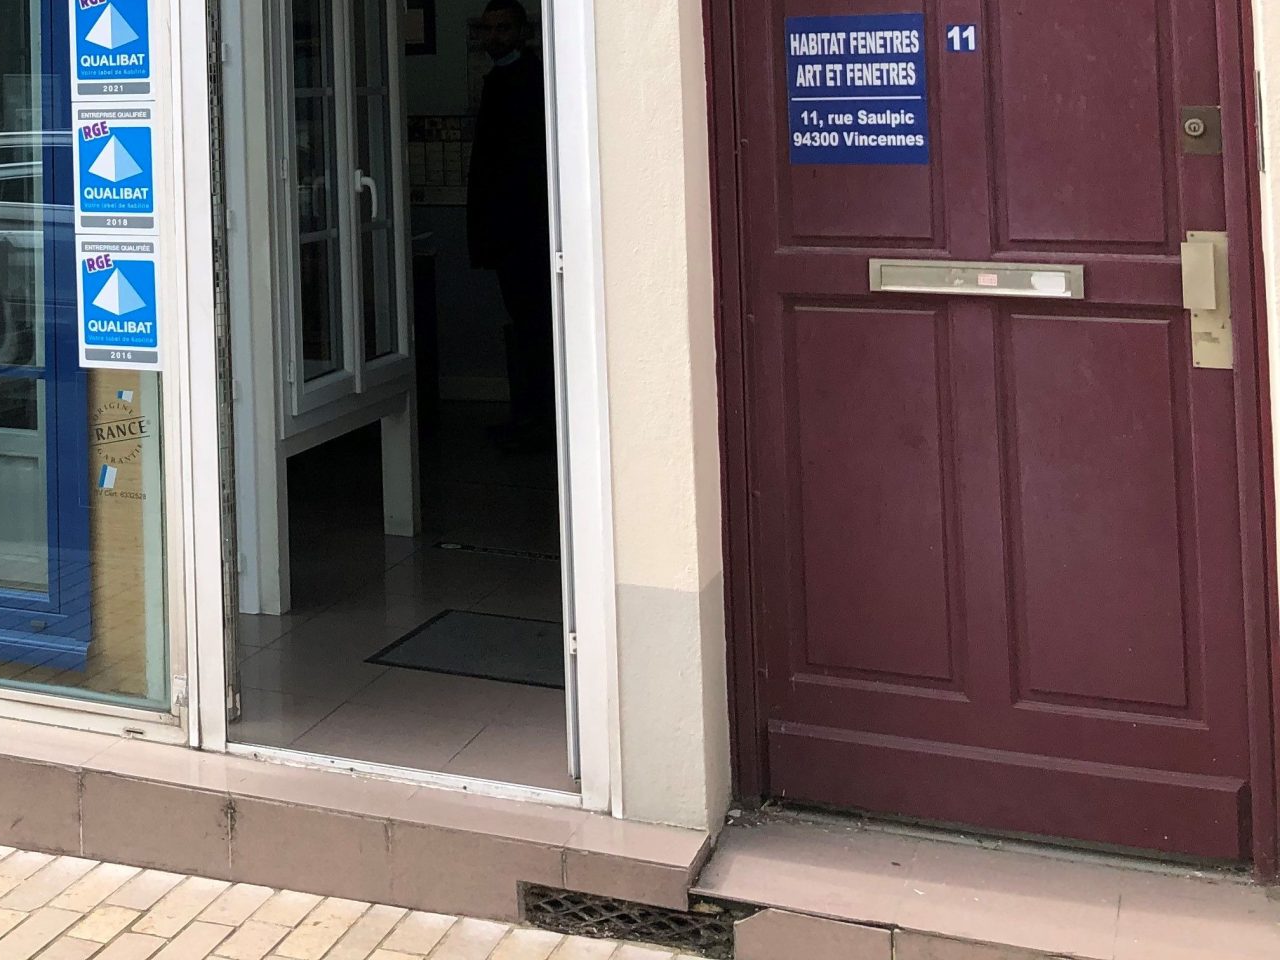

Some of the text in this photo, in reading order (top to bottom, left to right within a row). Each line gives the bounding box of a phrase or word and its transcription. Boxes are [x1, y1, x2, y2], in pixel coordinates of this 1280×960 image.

[790, 30, 919, 55] HABITAT FENETRES
[947, 25, 976, 50] 11
[80, 54, 145, 67] QUALIBAT
[796, 62, 916, 87] ART ET FENETRES
[801, 110, 915, 128] 11, rue Saulpic
[83, 121, 108, 139] RGE
[793, 131, 924, 146] 94300 Vincennes
[84, 187, 149, 199] QUALIBAT
[87, 254, 112, 271] RGE
[88, 320, 152, 333] QUALIBAT
[110, 351, 132, 359] 2016
[91, 420, 147, 441] RANCE
